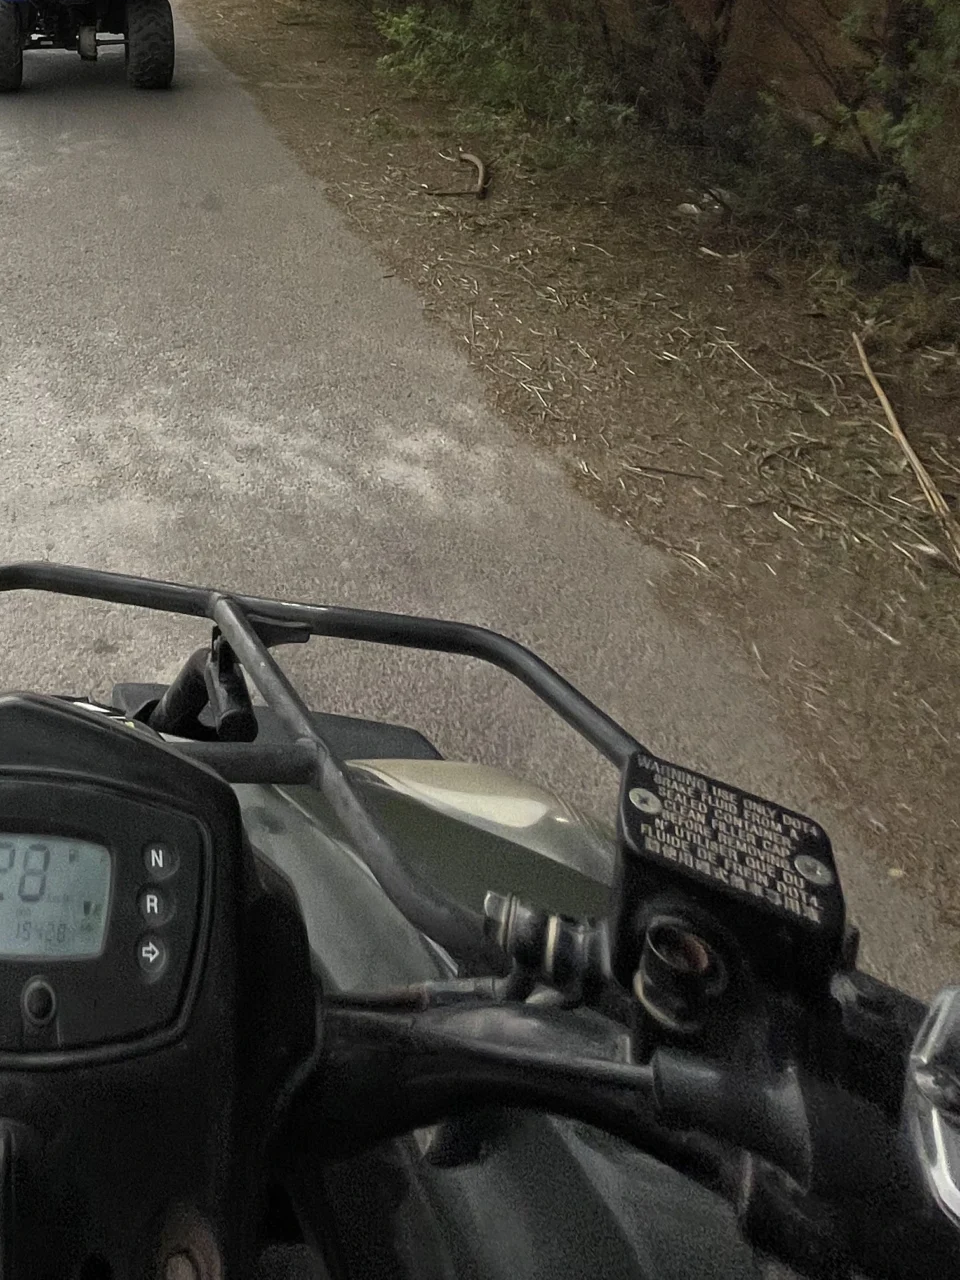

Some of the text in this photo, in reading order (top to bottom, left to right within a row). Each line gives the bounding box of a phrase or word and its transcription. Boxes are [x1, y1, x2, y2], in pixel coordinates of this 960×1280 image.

[658, 785, 707, 814] SEALED
[701, 791, 737, 815] FLUID
[743, 808, 782, 833] FROM
[789, 827, 798, 840] A
[663, 798, 790, 859] CLEAN FILLER CAP
[150, 849, 164, 868] N
[640, 822, 690, 853] FLUIDE
[697, 846, 717, 864] DE
[724, 857, 768, 887] FREIN
[674, 825, 737, 862] UTILISER
[745, 855, 776, 878] QUE
[783, 870, 804, 889] DU
[145, 894, 159, 914] R
